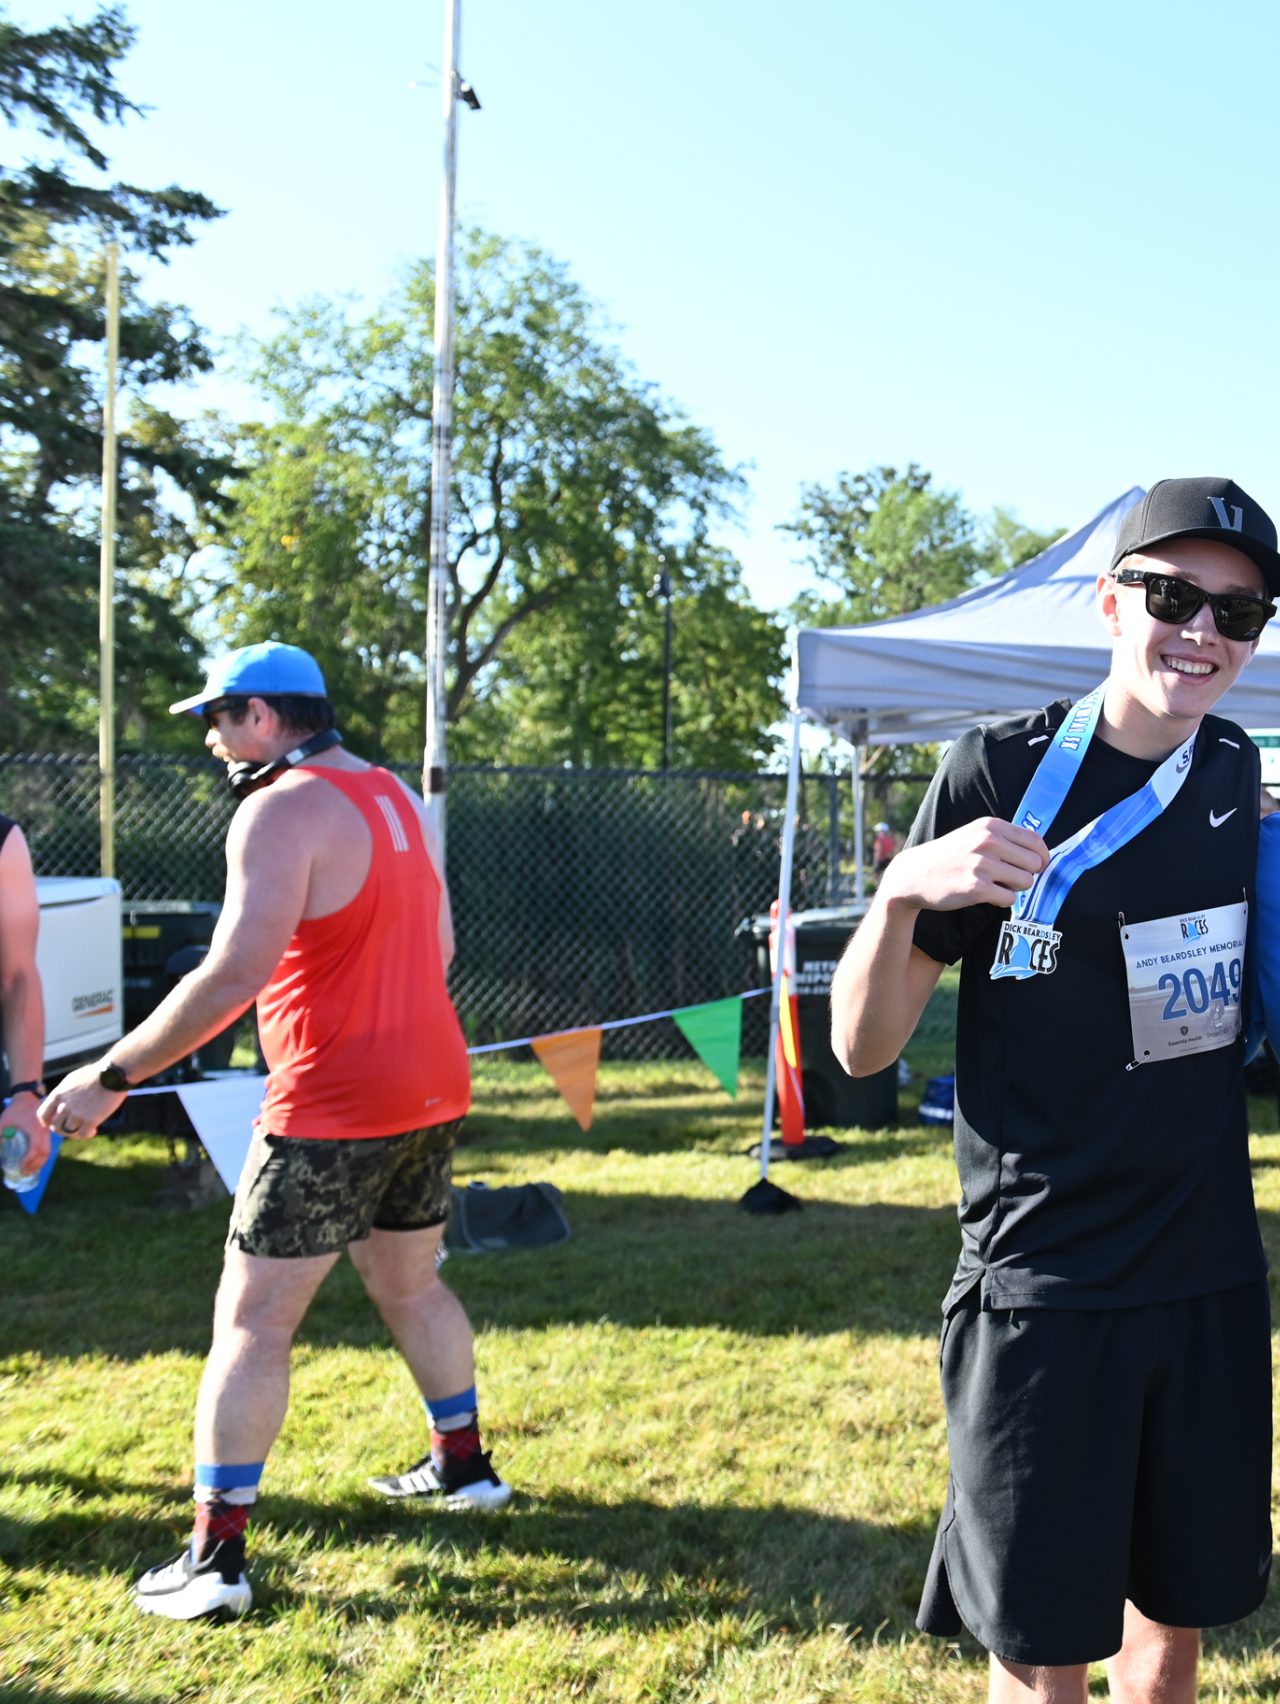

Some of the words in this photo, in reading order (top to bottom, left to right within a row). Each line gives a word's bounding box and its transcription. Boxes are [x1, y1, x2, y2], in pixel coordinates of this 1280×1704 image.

[1004, 923, 1021, 933] DICK
[1023, 927, 1061, 941] BEARDSLEY
[1136, 957, 1158, 968] ANDY
[1160, 947, 1207, 964] BEARDSLEY
[1158, 958, 1241, 1020] 2049
